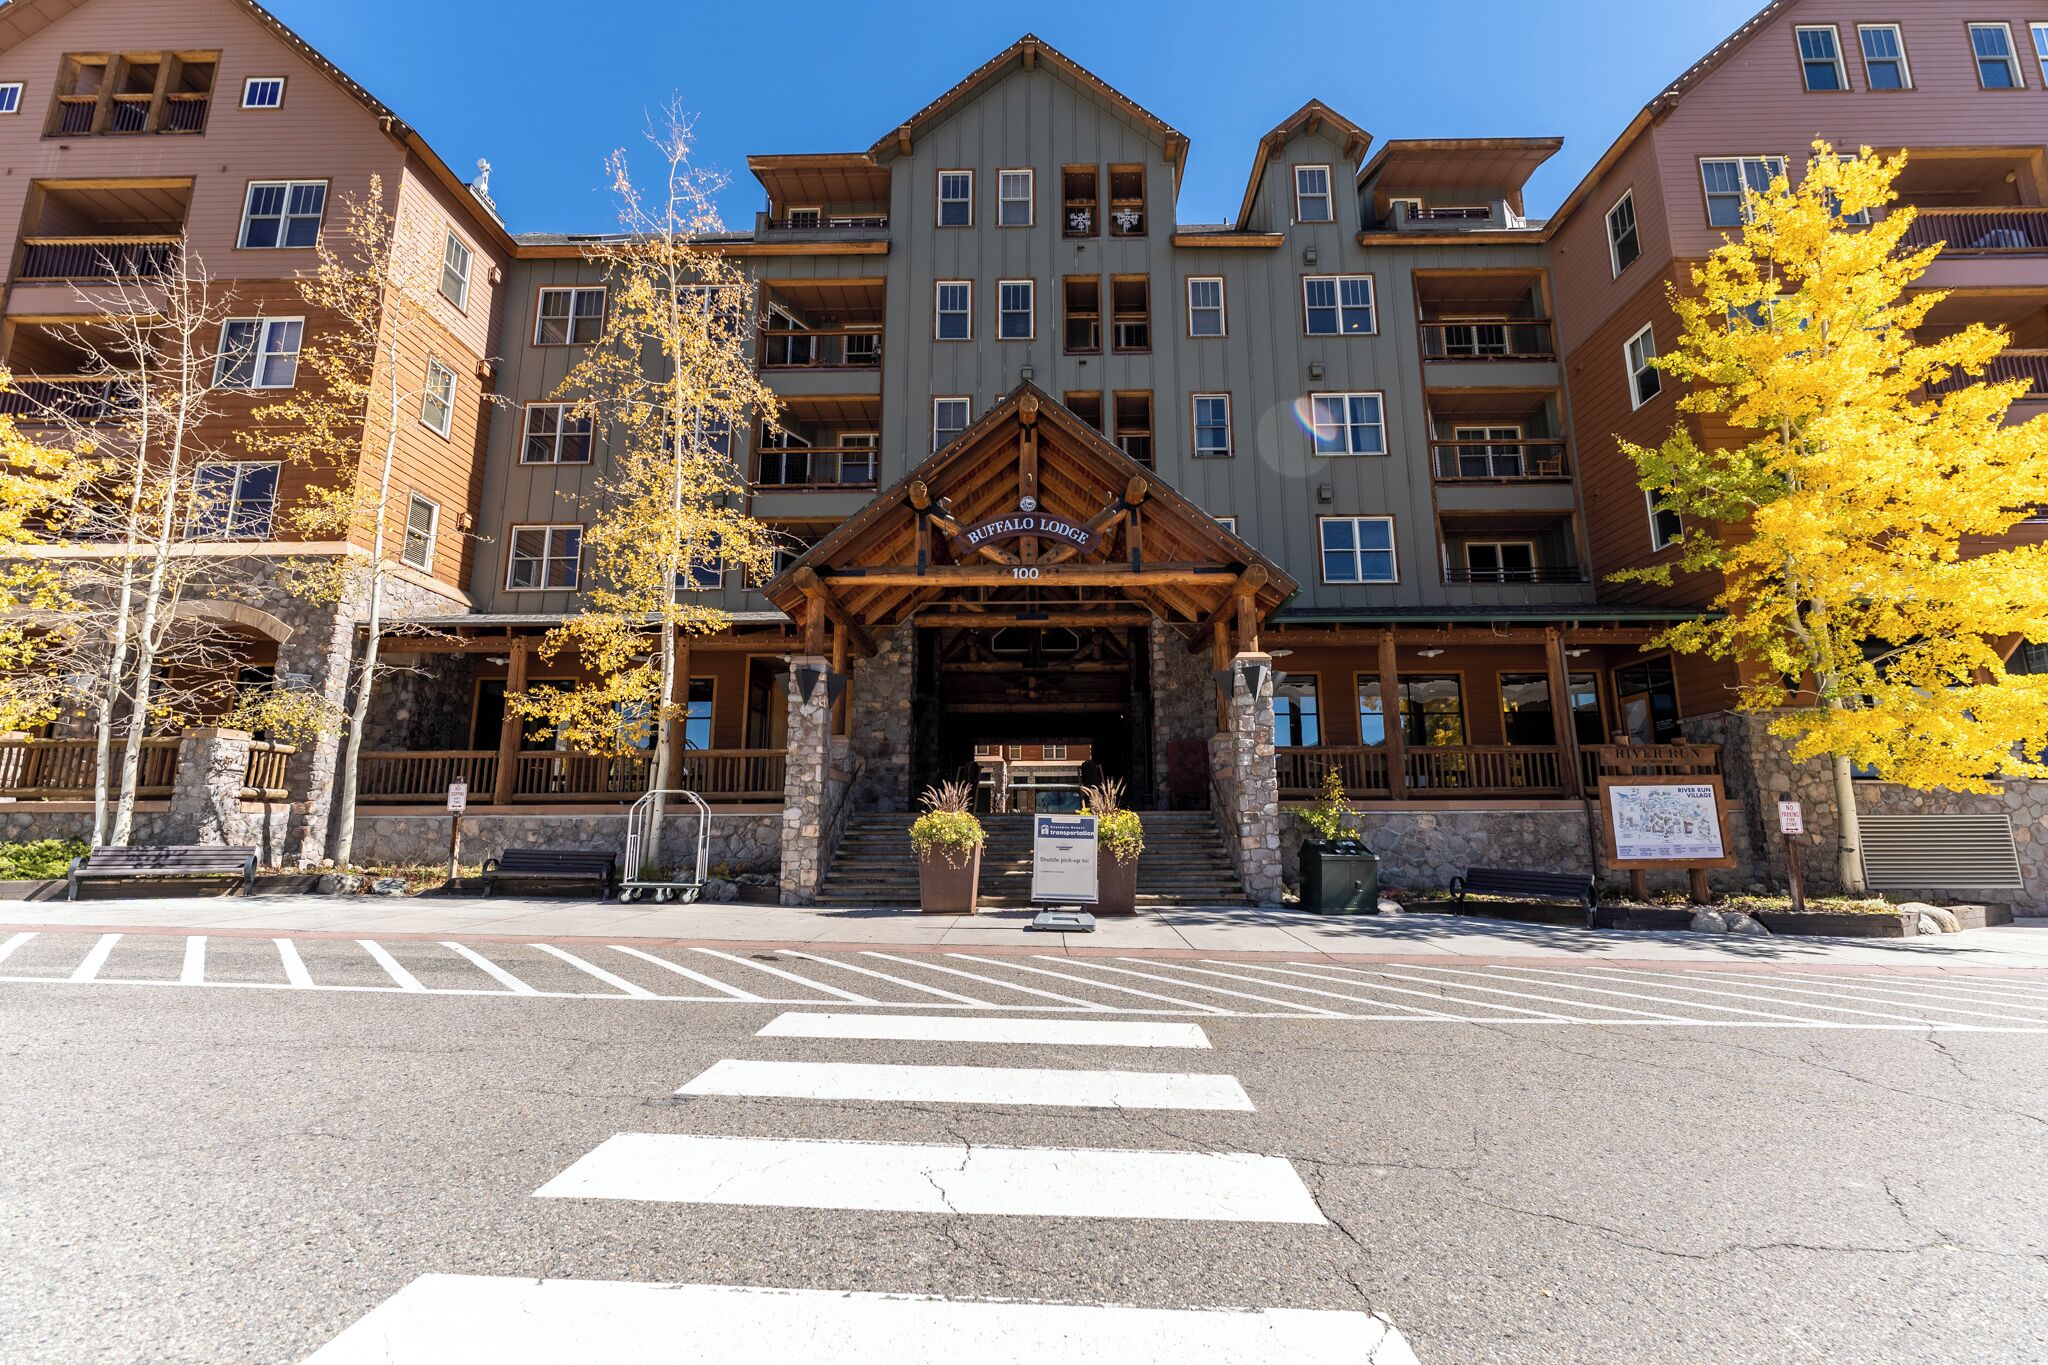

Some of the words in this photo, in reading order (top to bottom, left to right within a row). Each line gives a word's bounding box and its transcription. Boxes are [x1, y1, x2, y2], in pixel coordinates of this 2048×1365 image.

[967, 518, 1034, 544] BUFFALO
[1040, 519, 1089, 544] LODGE
[1012, 568, 1039, 579] 100
[1615, 748, 1662, 759] RIVER
[1668, 748, 1700, 759] RUN
